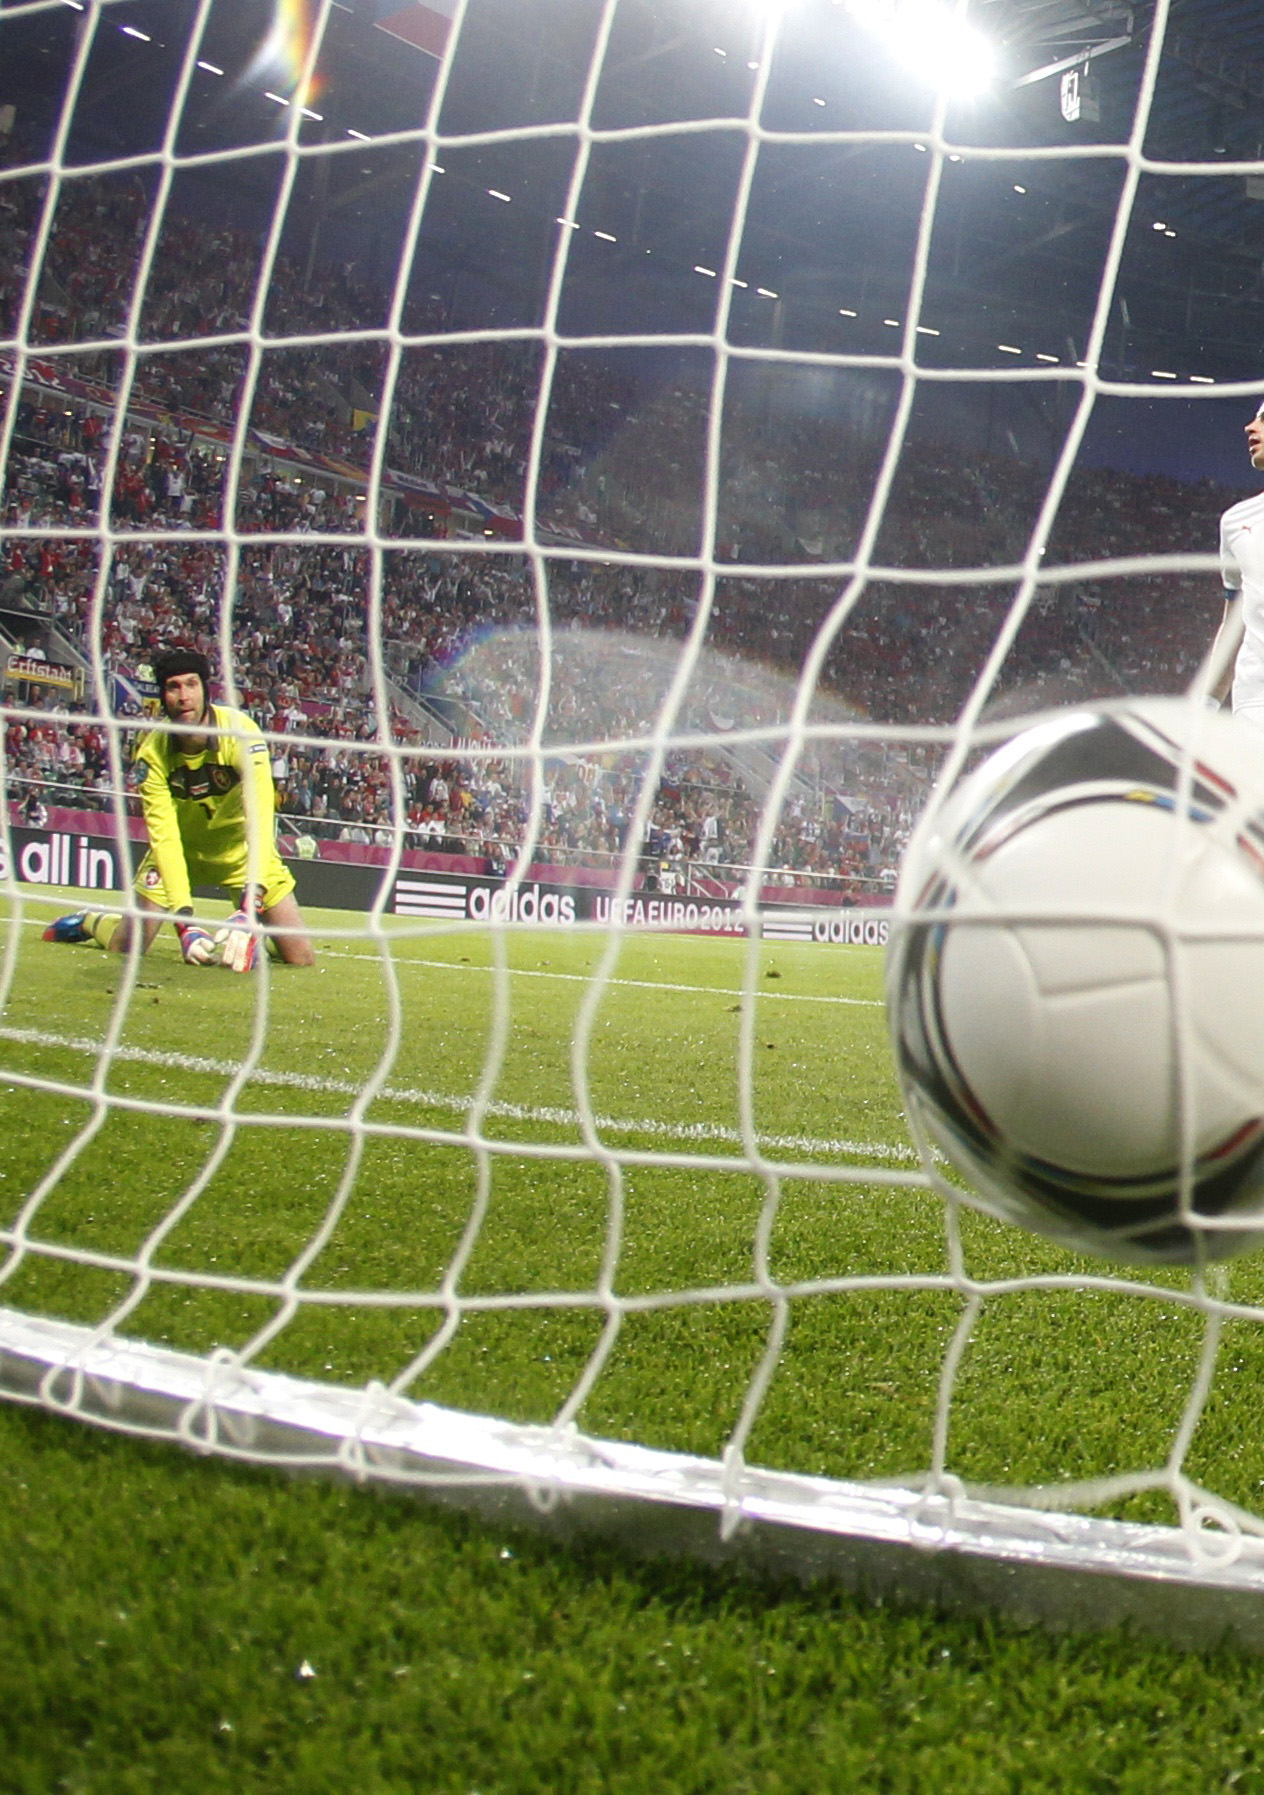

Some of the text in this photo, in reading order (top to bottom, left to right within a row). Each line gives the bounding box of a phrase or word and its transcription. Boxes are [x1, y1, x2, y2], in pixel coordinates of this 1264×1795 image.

[21, 834, 70, 885] all
[78, 836, 114, 889] in
[469, 883, 576, 925] adidas
[701, 906, 744, 932] 2012
[815, 909, 890, 946] adidas
